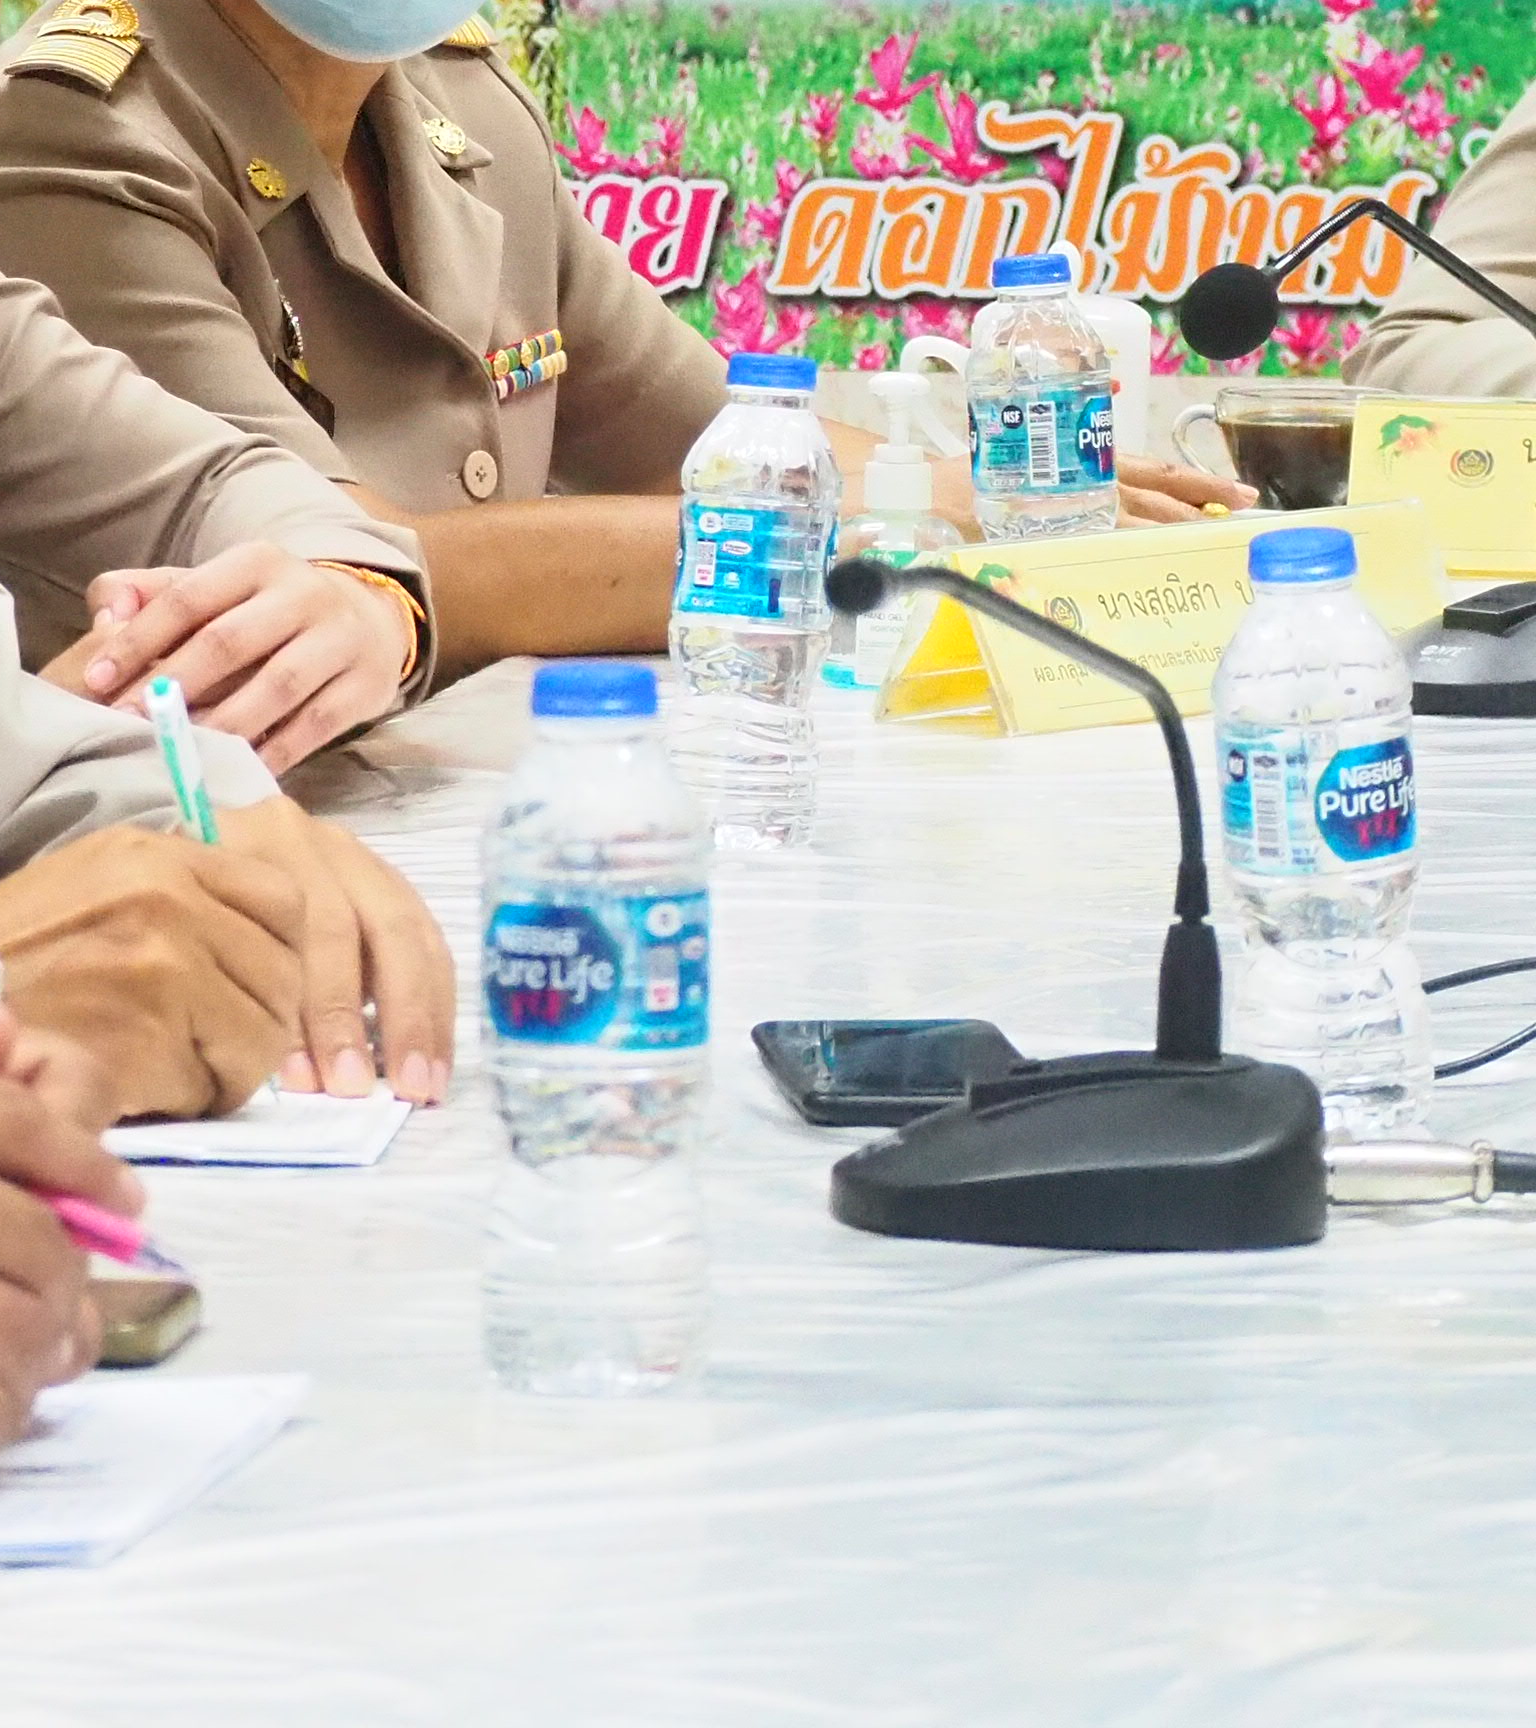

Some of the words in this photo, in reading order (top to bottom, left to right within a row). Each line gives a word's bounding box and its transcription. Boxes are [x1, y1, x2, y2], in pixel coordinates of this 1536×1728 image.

[570, 176, 726, 292] าย
[1097, 572, 1221, 629] นางสุณิสา
[1318, 789, 1386, 821] Pure
